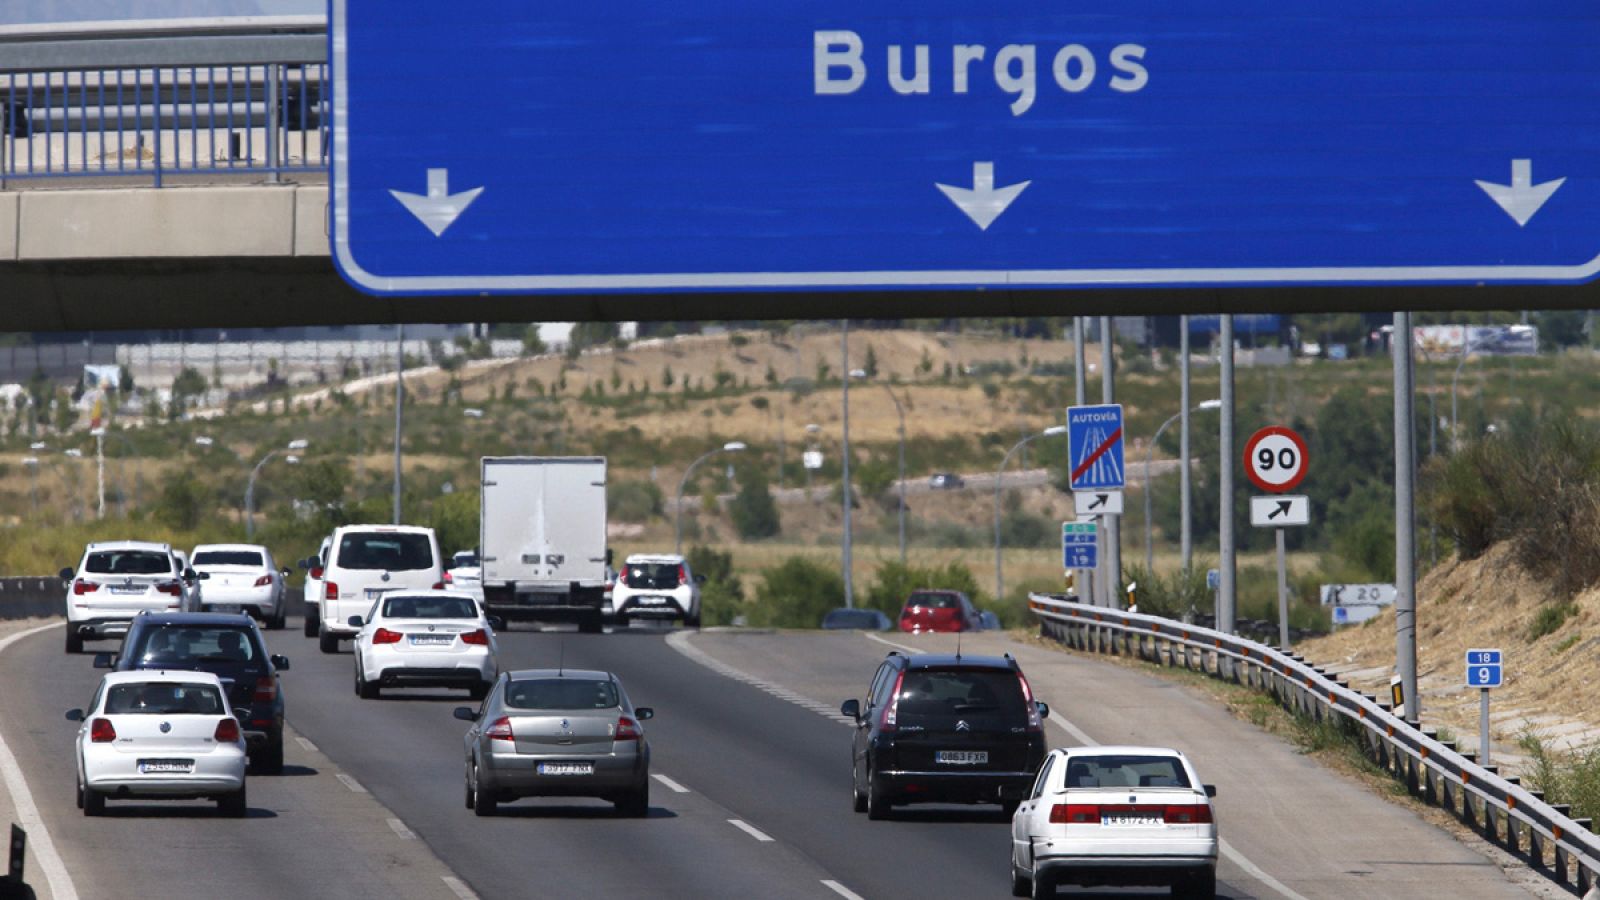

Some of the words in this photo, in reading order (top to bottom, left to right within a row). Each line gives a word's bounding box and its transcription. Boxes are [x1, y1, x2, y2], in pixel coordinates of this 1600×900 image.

[813, 29, 1149, 117] Burgos
[1258, 447, 1296, 470] 90
[1358, 587, 1380, 601] 20
[1478, 653, 1491, 663] 18
[1479, 667, 1490, 684] 9
